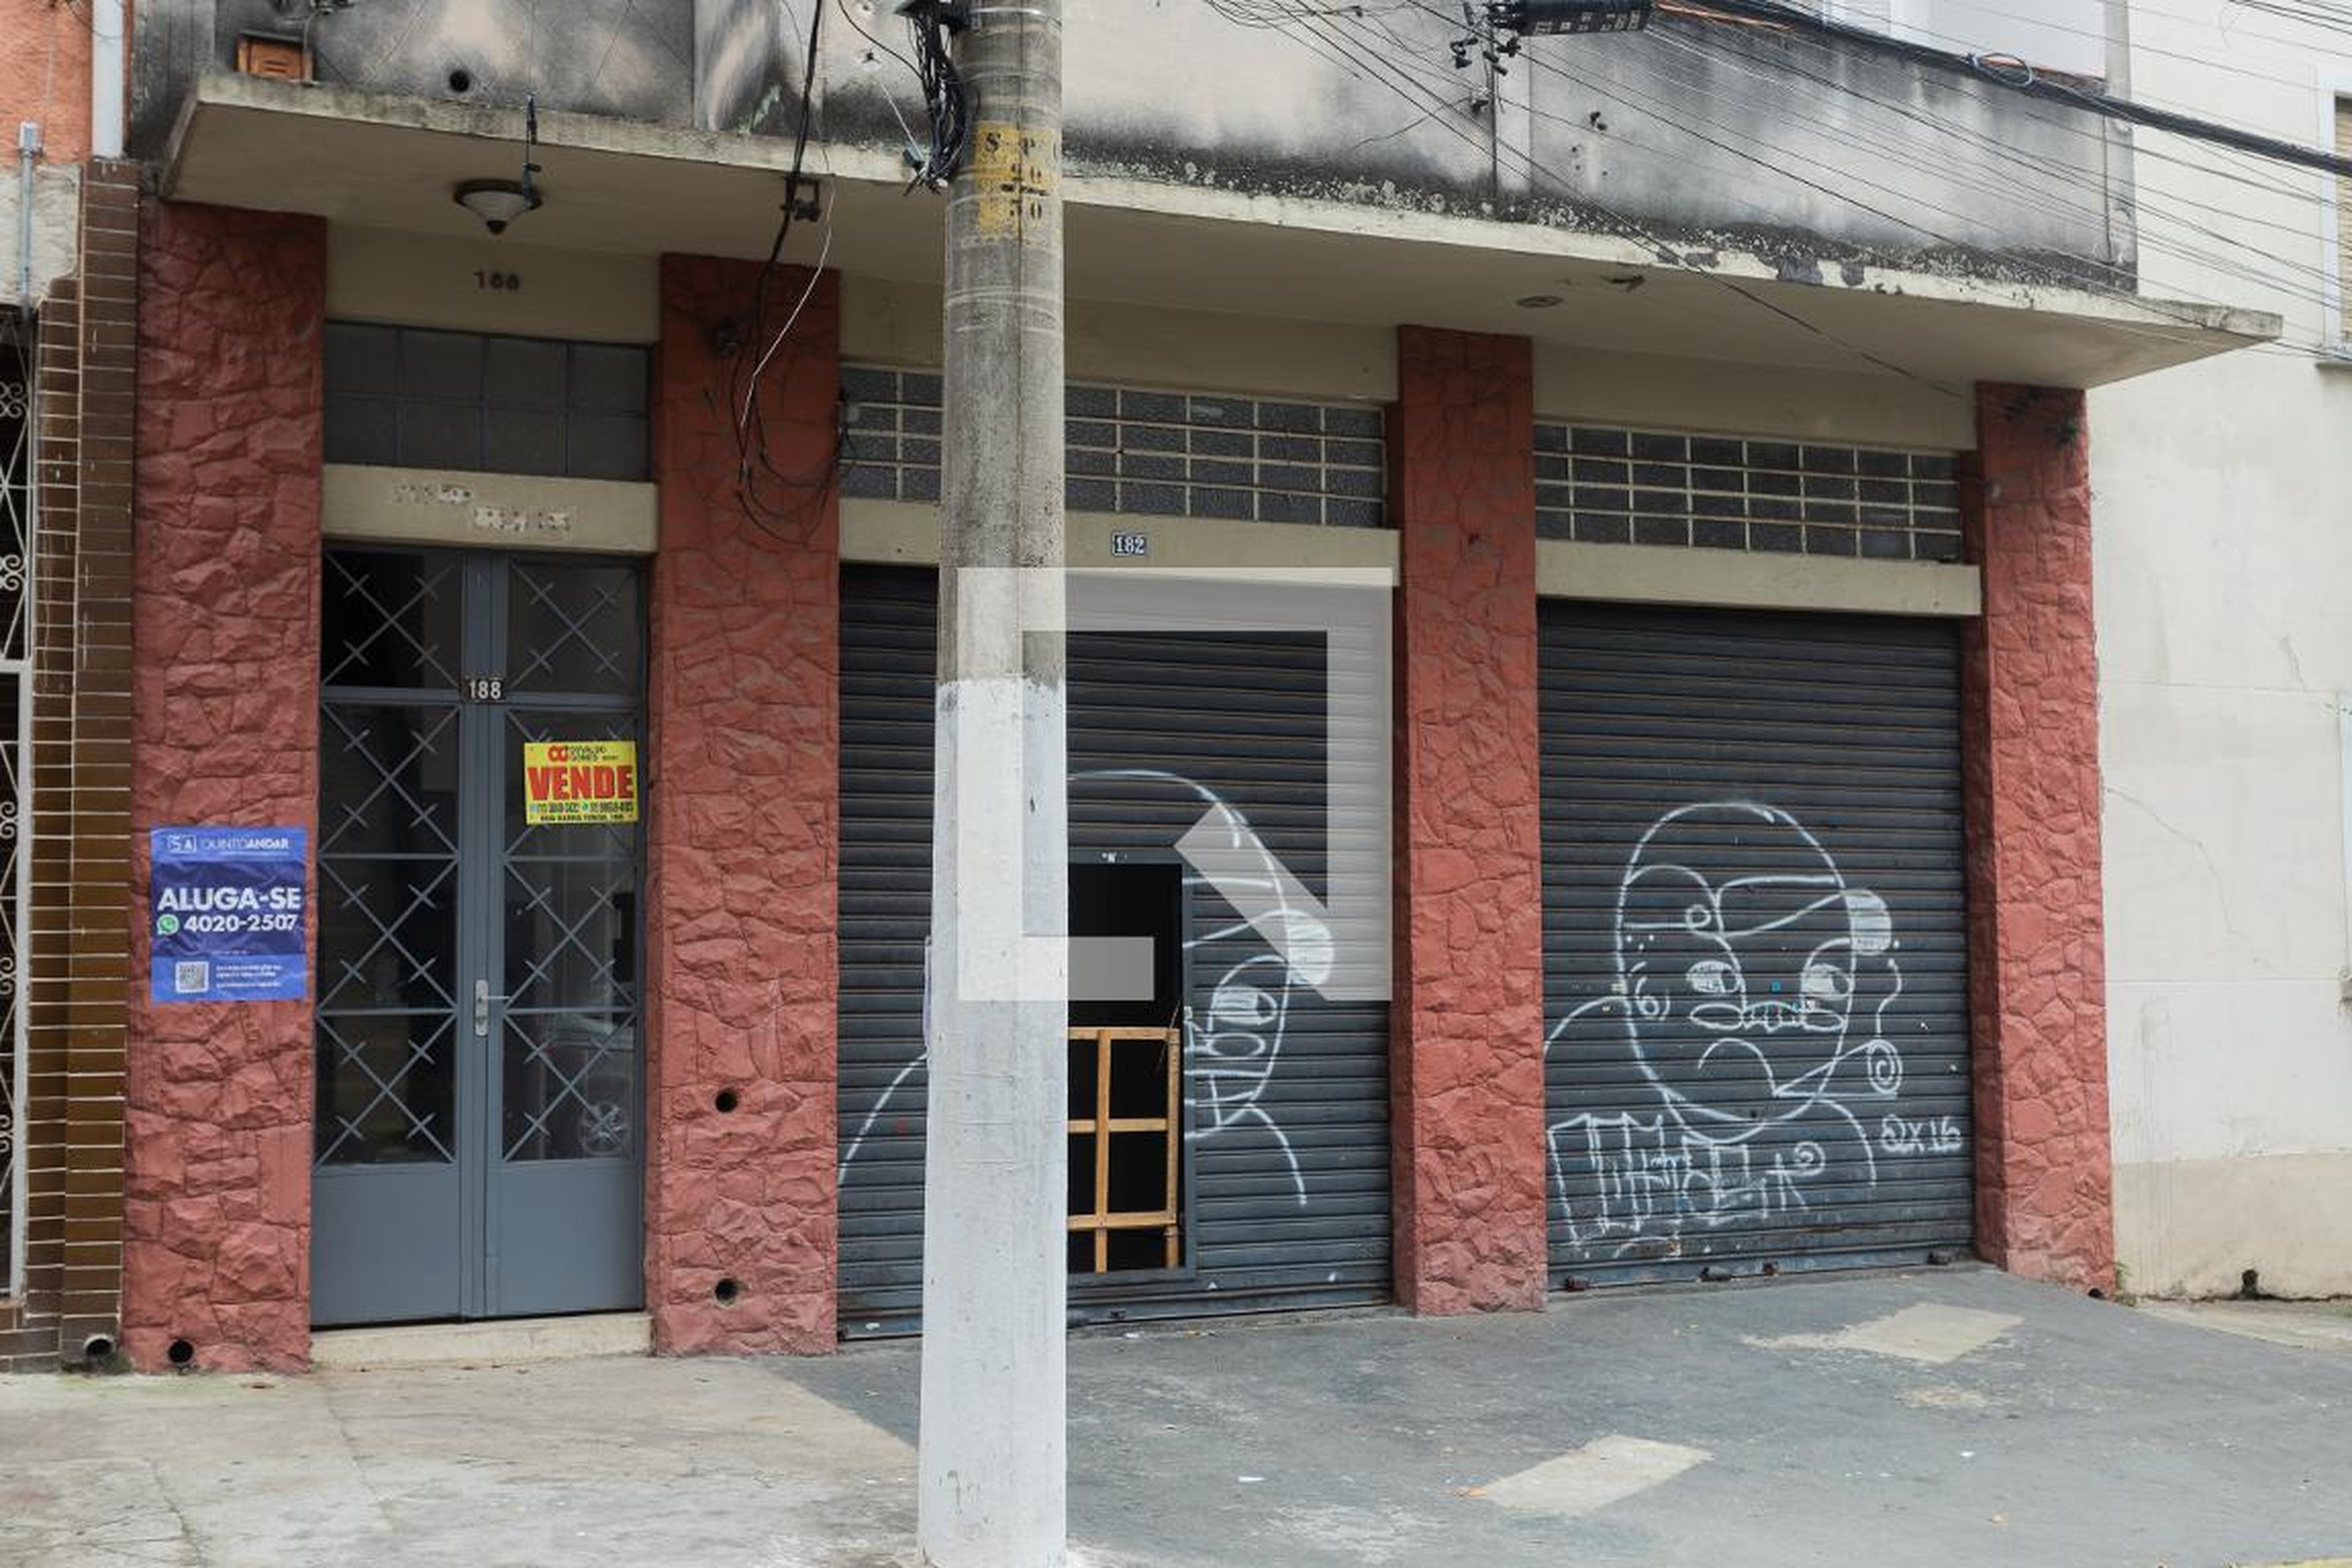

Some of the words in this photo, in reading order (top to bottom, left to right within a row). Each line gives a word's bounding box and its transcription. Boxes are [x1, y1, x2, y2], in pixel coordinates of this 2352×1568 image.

[1117, 536, 1145, 554] 182
[469, 680, 502, 699] 188
[526, 765, 635, 801] VENDE
[157, 888, 301, 911] ALUGA-SE
[184, 914, 298, 933] 4020-2507
